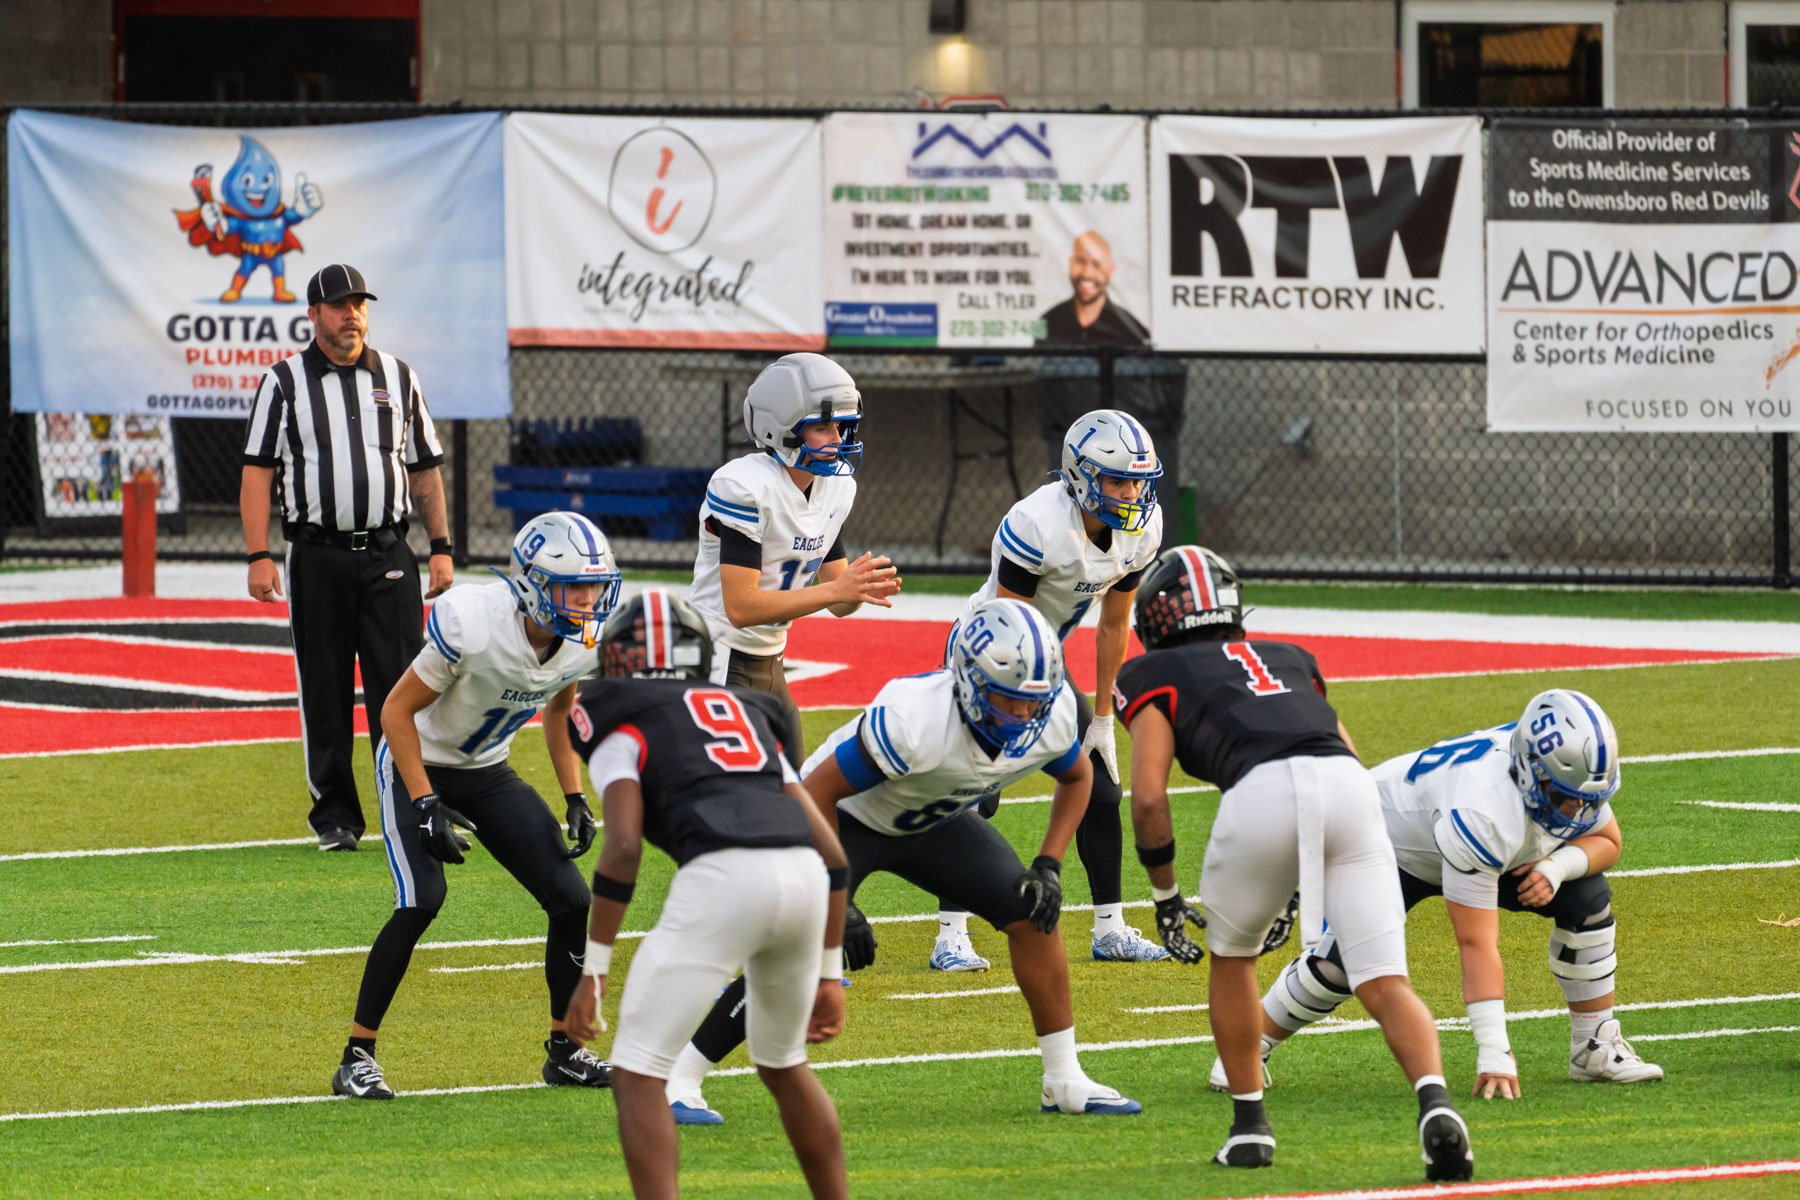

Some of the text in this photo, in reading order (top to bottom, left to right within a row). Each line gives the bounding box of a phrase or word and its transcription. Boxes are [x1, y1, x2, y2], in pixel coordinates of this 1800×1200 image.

[1553, 129, 1716, 152] Official Provider of
[1529, 158, 1751, 182] Sports Medicine Services
[1508, 189, 1769, 212] to the Owensboro Red Devils
[920, 214, 967, 230] DREAM
[1168, 153, 1464, 279] RTW
[844, 242, 924, 257] INVESTMENT
[577, 251, 754, 323] integrated
[875, 269, 908, 285] HERE
[913, 269, 929, 285] TO
[934, 269, 969, 285] WORK
[975, 269, 999, 285] FOR
[1005, 269, 1034, 286] YOU.
[1501, 248, 1799, 305] ADVANCED
[958, 292, 990, 309] CALL
[1171, 285, 1445, 311] REFRACTORY INC.
[167, 314, 312, 343] GOTTA G
[1513, 319, 1774, 345] Center for Orthopedics
[185, 348, 302, 365] PLUMBI
[1512, 344, 1715, 367] & Sports Medicine
[147, 395, 252, 410] GOTTAGOPL
[1585, 400, 1792, 418] FOCUSED ON YOU
[1078, 427, 1096, 449] 1
[520, 527, 546, 560] 19
[792, 534, 825, 551] EAGLES
[1184, 611, 1233, 629] Riddell
[964, 616, 995, 656] 60
[1222, 642, 1292, 696] 1
[683, 688, 768, 772] 9
[1530, 712, 1564, 756] 56
